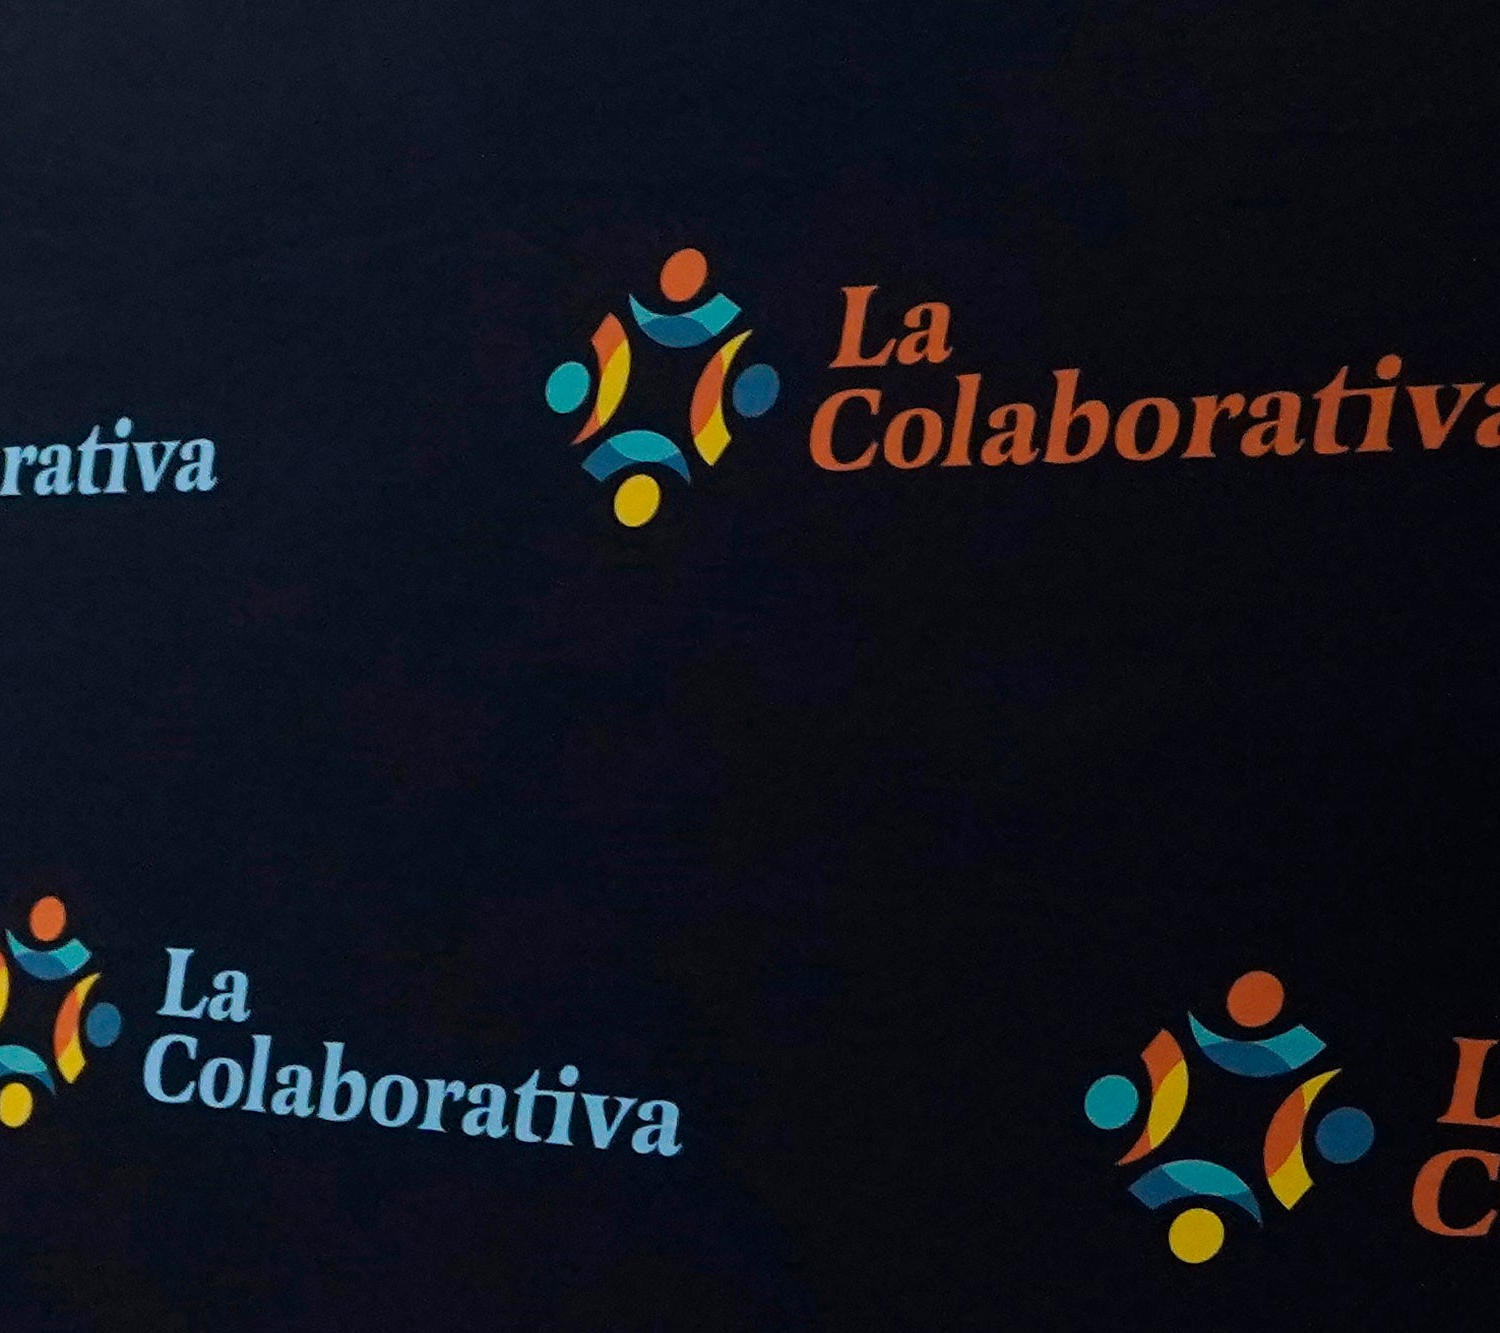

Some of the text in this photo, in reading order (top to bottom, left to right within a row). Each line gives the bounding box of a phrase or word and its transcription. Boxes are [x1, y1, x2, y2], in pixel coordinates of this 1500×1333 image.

[829, 284, 953, 369] La
[157, 947, 252, 1024] La
[143, 1033, 684, 1157] Colaborativa
[1437, 1036, 1500, 1129] L
